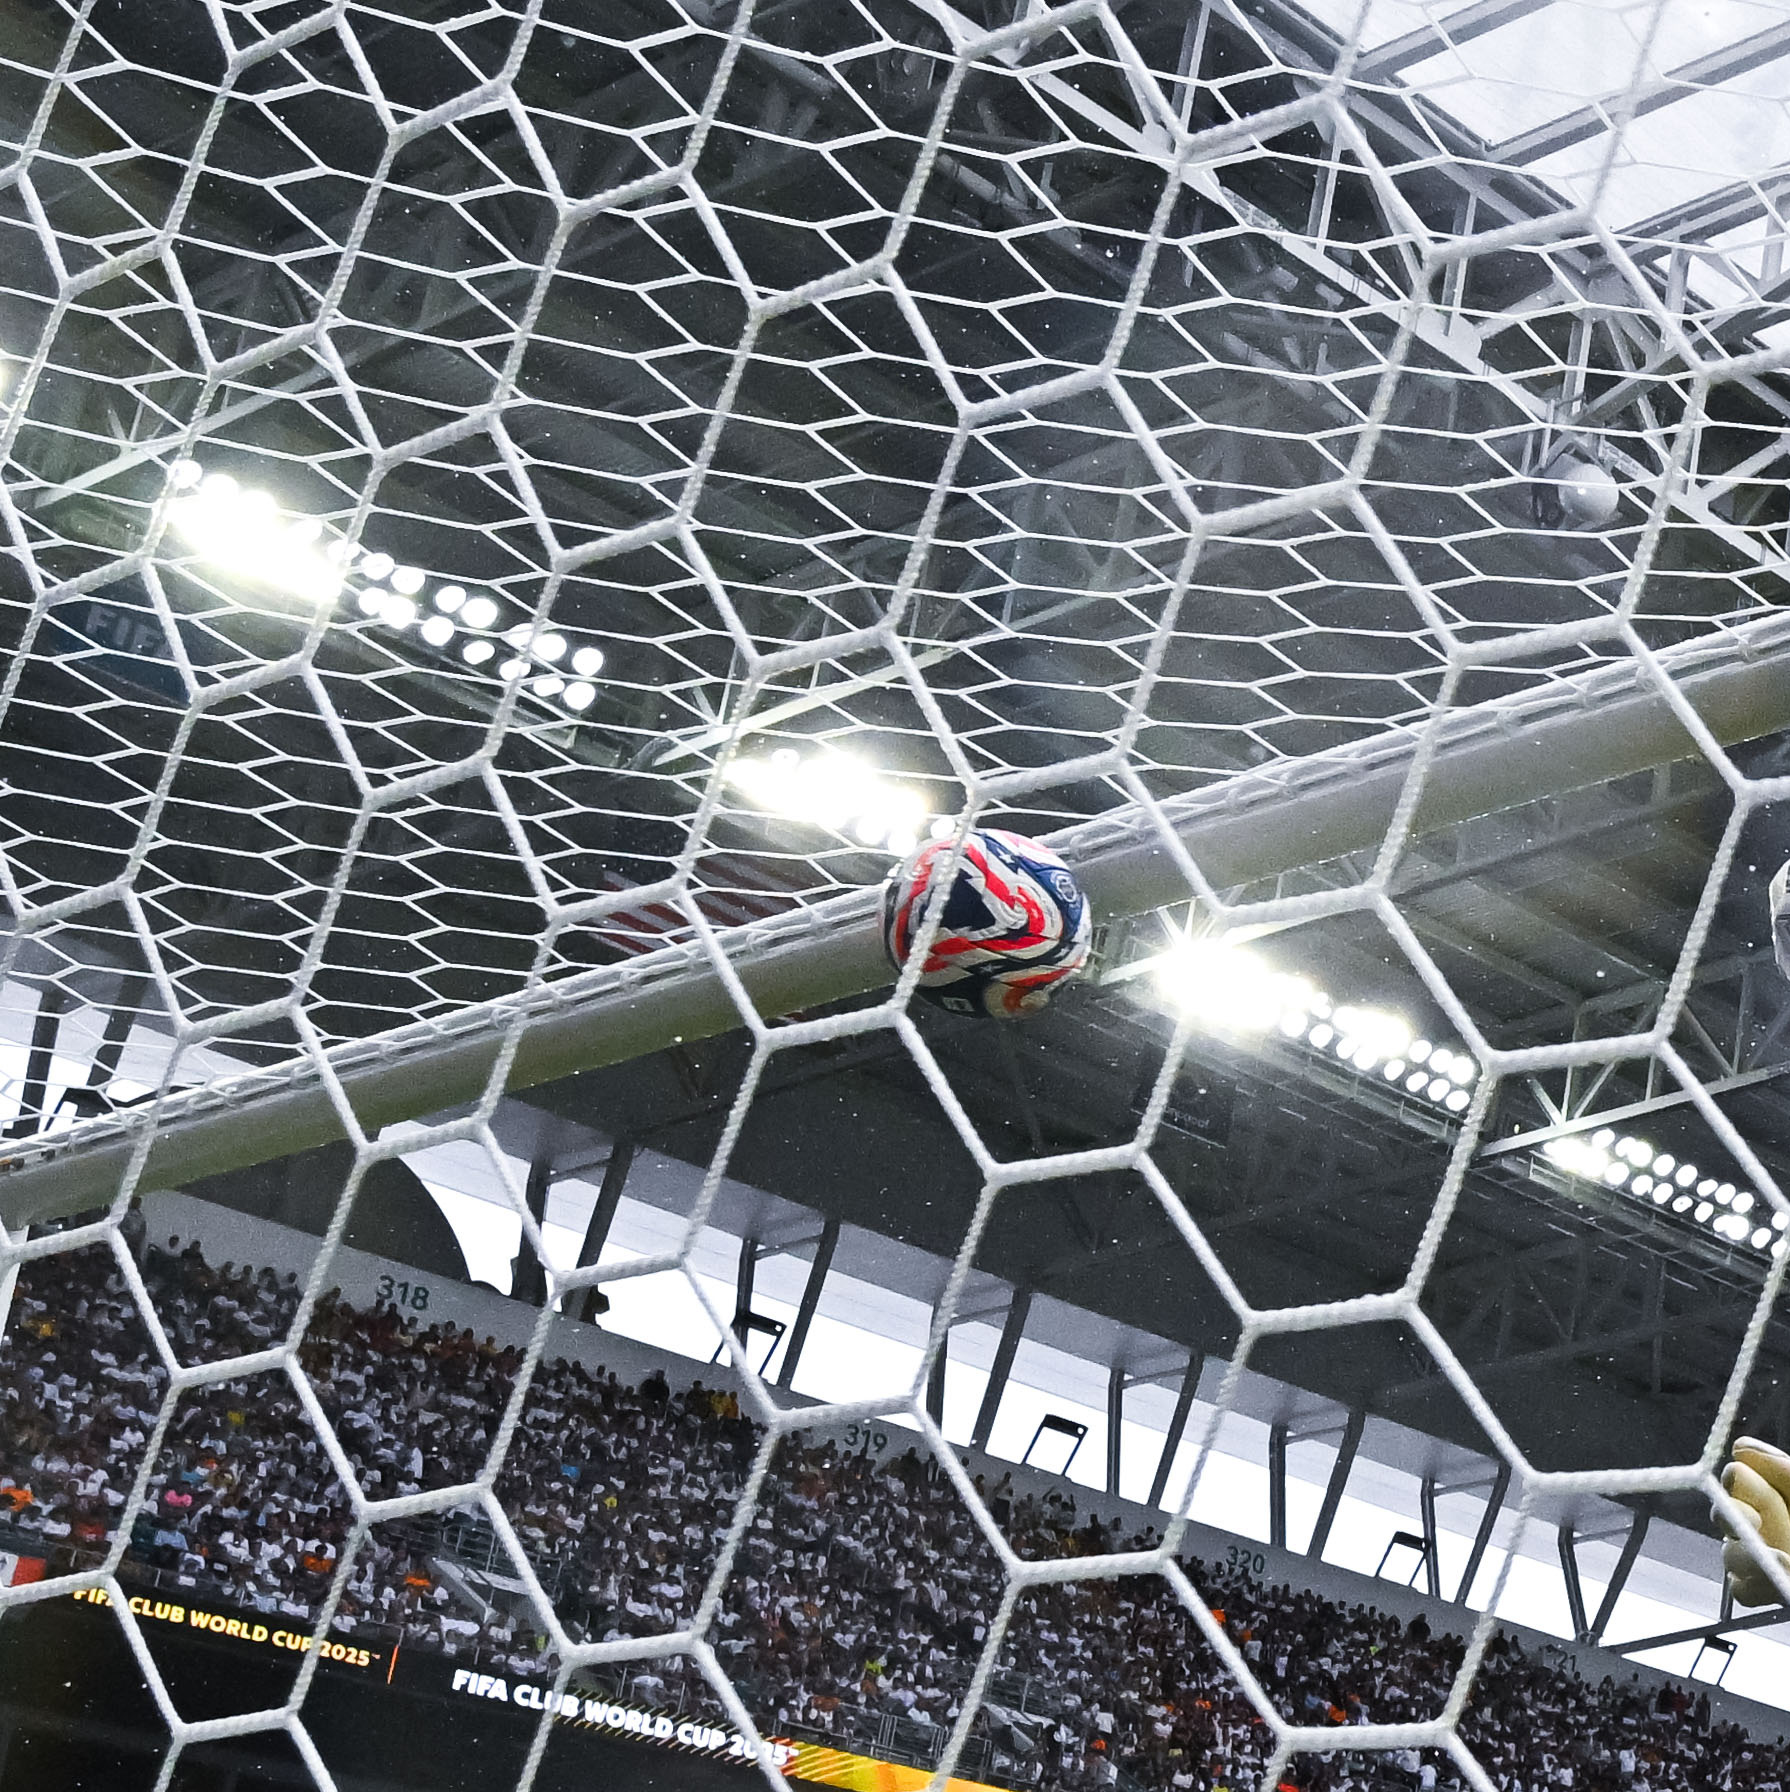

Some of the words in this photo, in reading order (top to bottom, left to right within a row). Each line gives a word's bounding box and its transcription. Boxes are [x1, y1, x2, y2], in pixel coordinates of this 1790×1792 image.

[376, 1273, 430, 1312] 318
[844, 1423, 888, 1454] 319
[1225, 1544, 1266, 1575] 320
[127, 1595, 186, 1624] CLUB
[189, 1609, 269, 1643] WORLD
[271, 1630, 315, 1657] CUP
[317, 1640, 371, 1667] 2025
[451, 1668, 509, 1702] FIFA
[584, 1698, 674, 1740] WORLD
[676, 1723, 727, 1751] CUP
